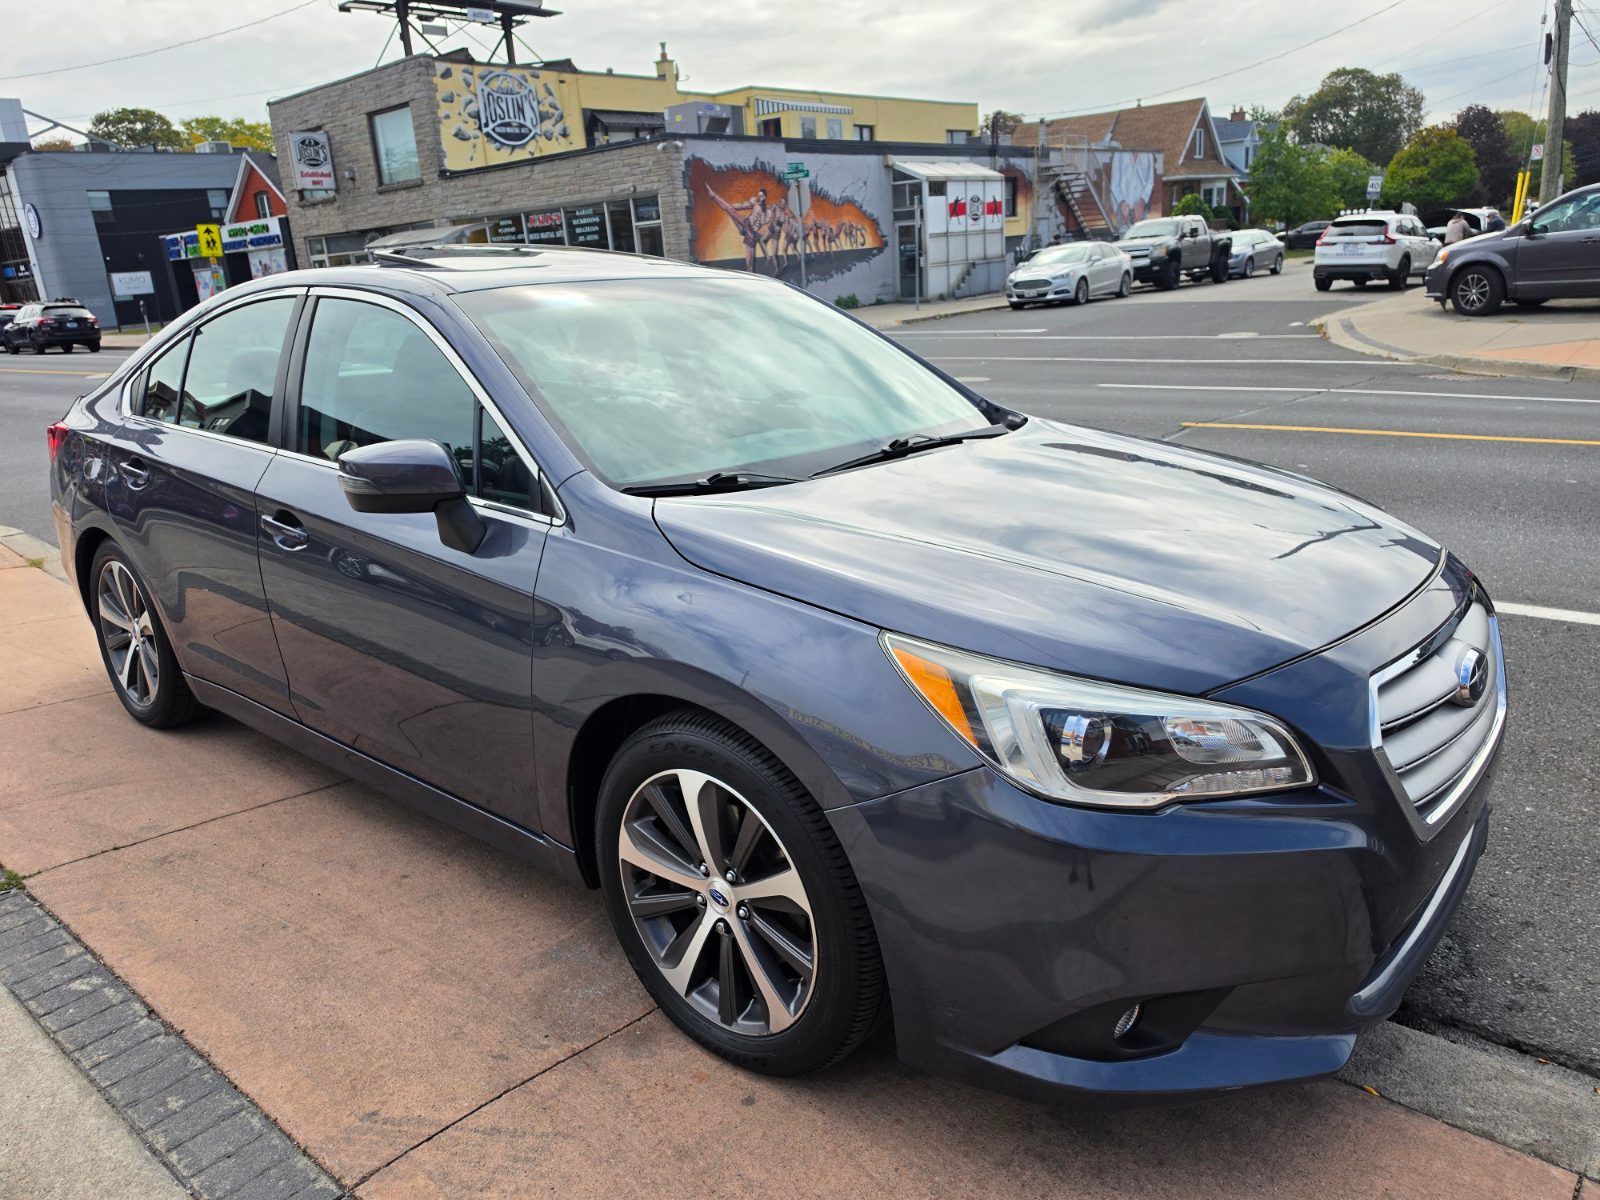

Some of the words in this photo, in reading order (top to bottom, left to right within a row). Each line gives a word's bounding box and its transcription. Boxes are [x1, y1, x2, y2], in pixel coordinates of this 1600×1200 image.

[481, 88, 538, 128] JOSLIN'S
[297, 143, 328, 162] JOSLIN'S
[648, 741, 738, 774] EAGLE
